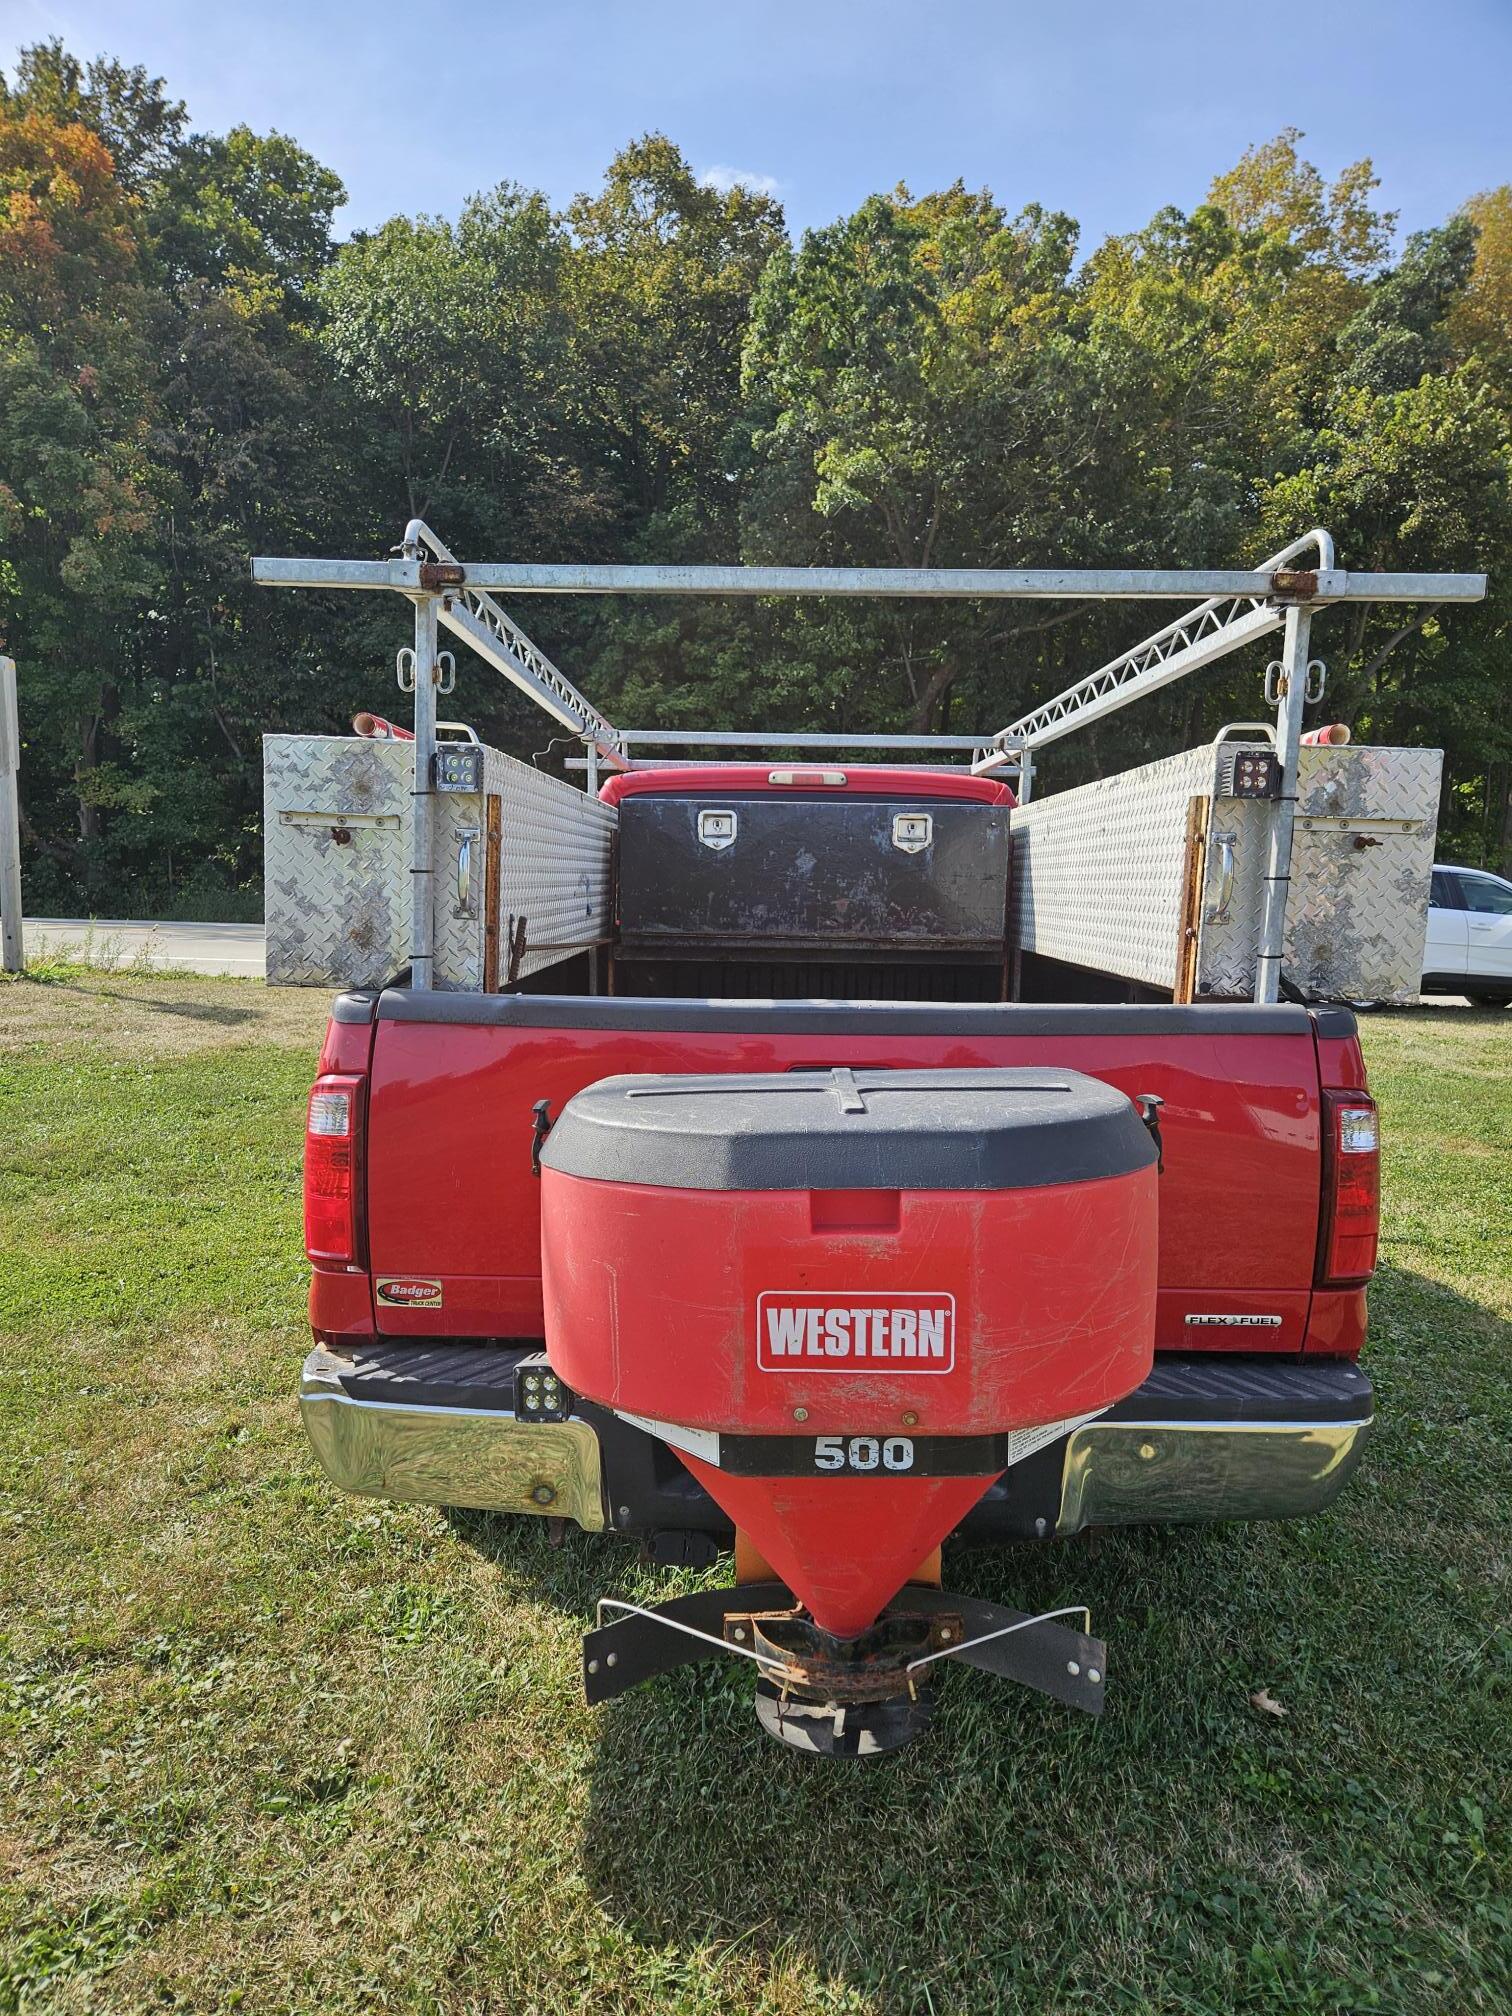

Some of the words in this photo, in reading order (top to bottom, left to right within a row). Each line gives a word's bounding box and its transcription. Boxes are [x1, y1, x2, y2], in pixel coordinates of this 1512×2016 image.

[390, 1284, 438, 1297] Badger
[766, 1307, 946, 1357] WESTERN
[1189, 1316, 1228, 1325] FLEX
[1240, 1317, 1279, 1325] FUEL
[814, 1436, 914, 1471] 500
